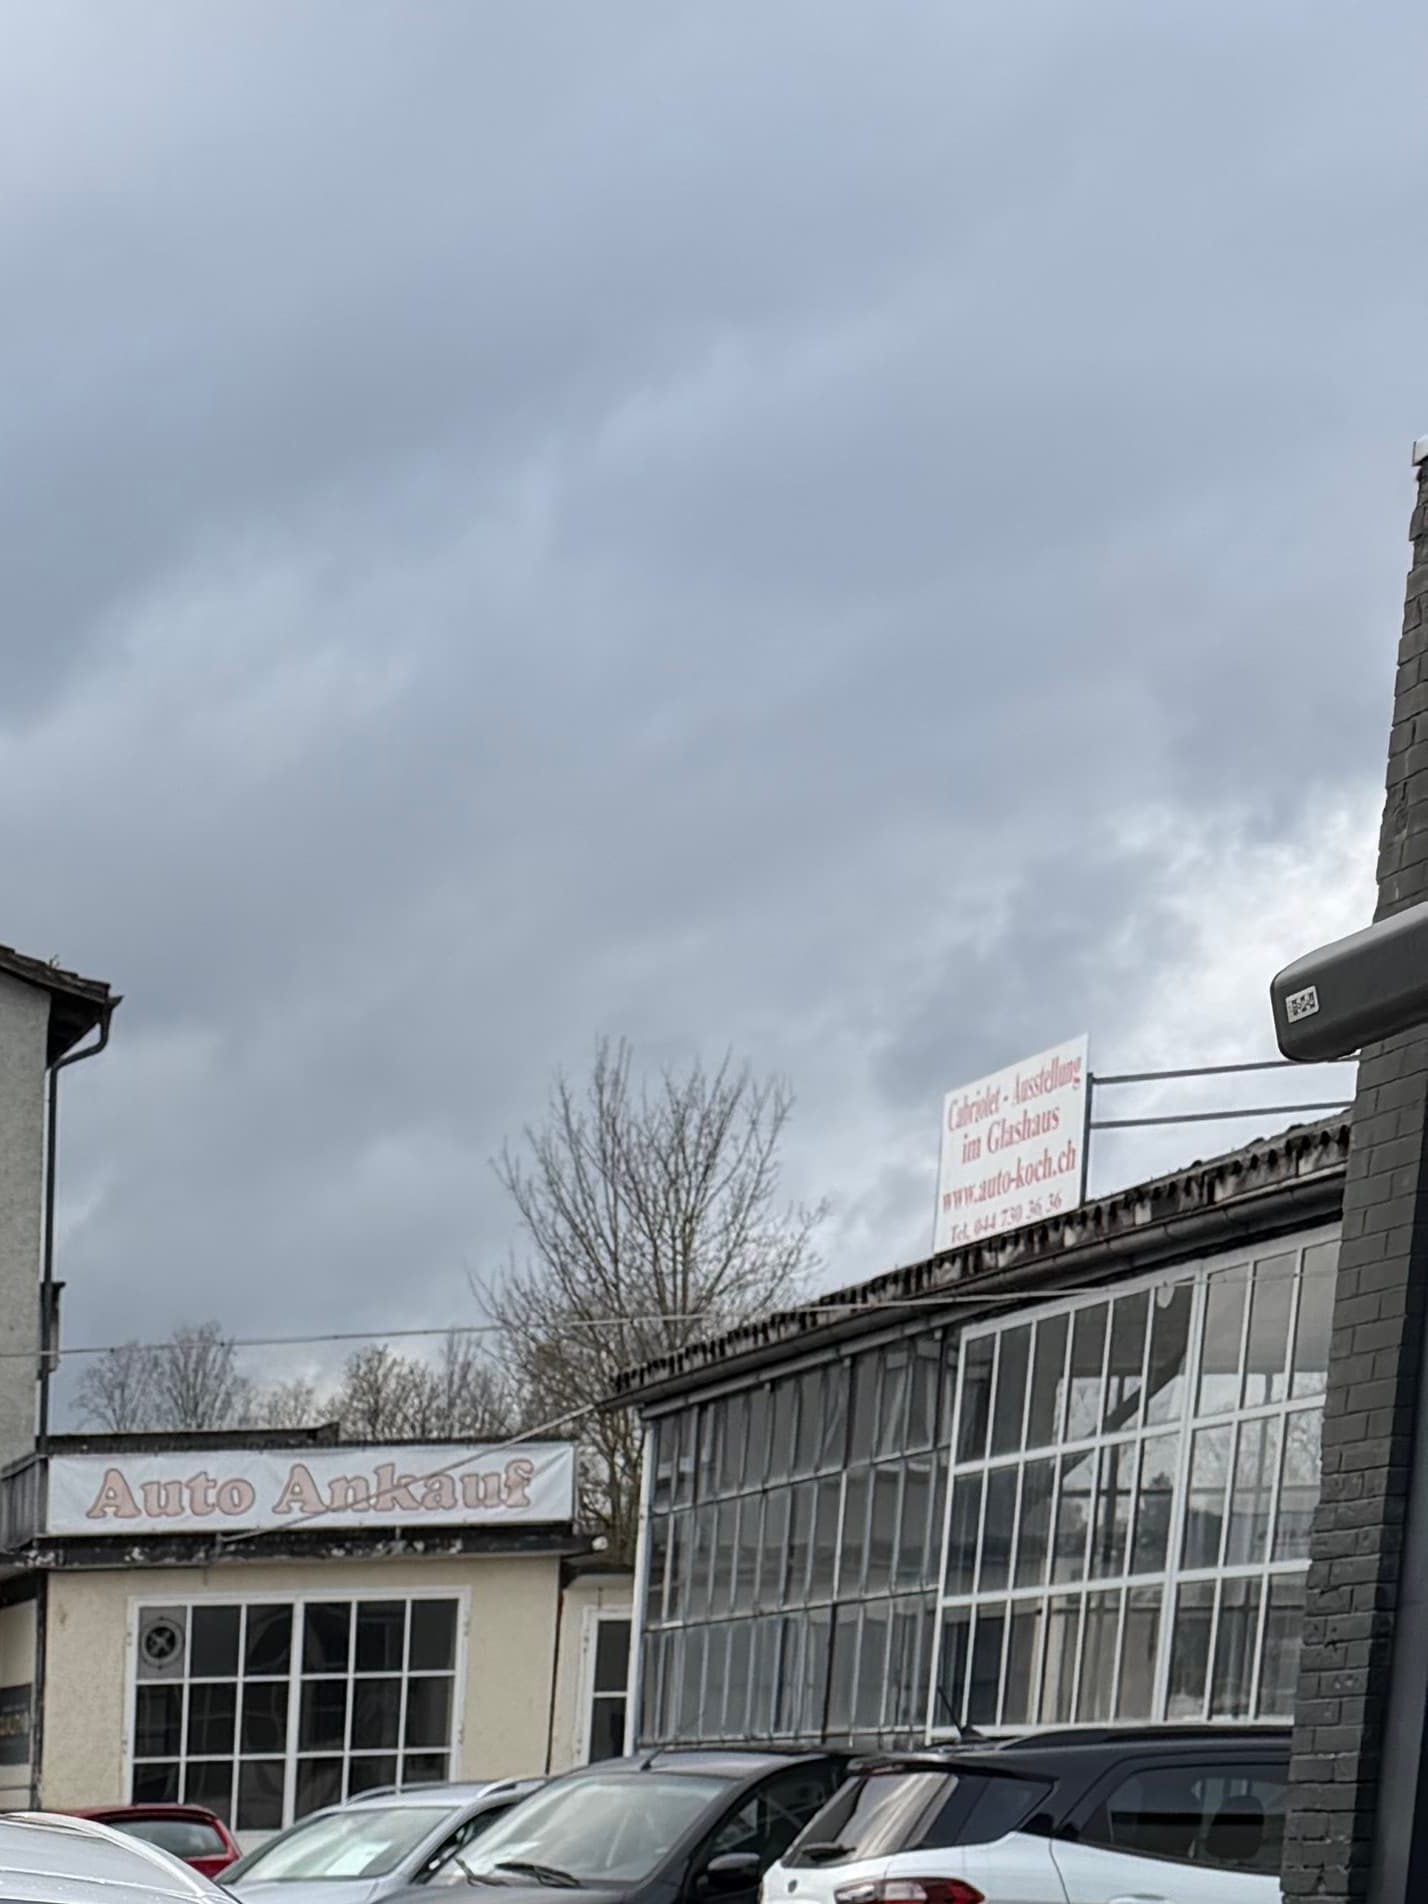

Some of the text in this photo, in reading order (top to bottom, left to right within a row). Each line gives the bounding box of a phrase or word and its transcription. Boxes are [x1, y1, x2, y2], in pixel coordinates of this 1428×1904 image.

[1012, 1056, 1082, 1106] Ausstellung
[962, 1107, 1060, 1165] im Glashaus
[943, 1139, 1077, 1213] www.auto-koch.ch
[974, 1212, 996, 1236] 044
[86, 1458, 534, 1519] Auto Ankauf
